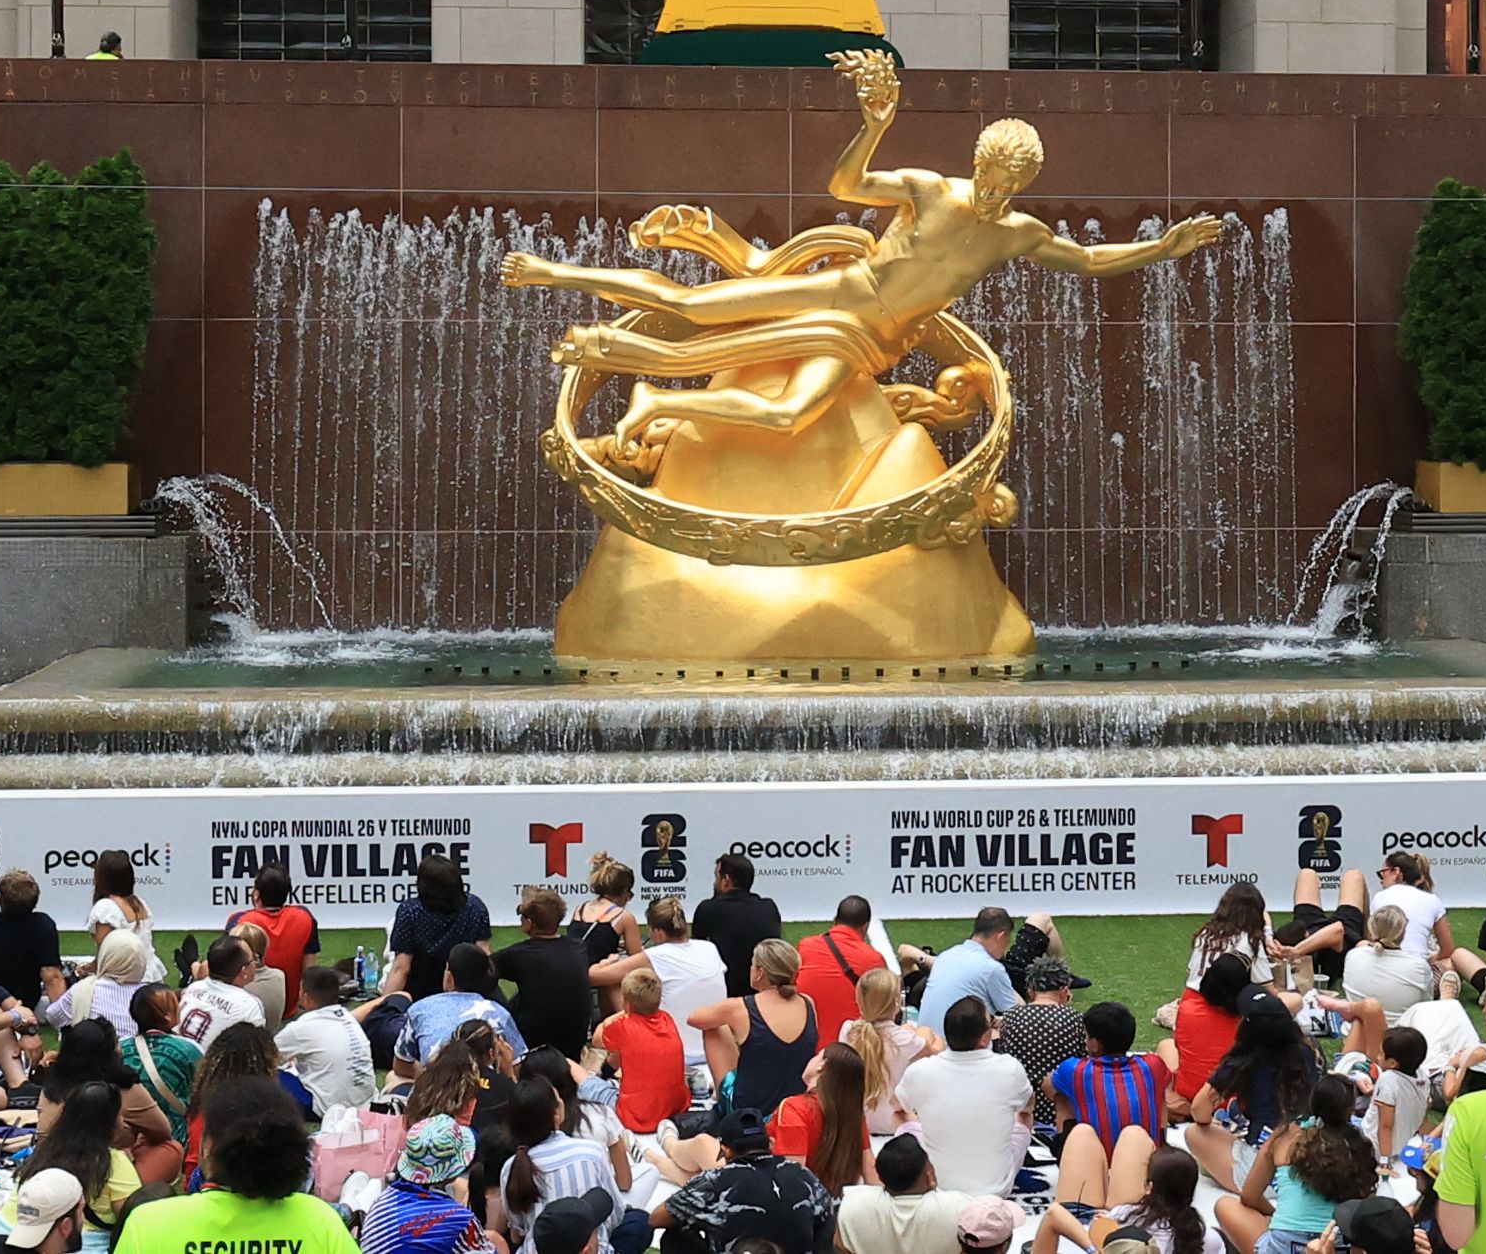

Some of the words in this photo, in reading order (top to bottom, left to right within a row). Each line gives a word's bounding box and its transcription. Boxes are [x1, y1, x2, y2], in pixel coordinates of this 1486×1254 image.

[212, 821, 249, 838] NYNJ
[252, 821, 288, 838] COPA
[292, 820, 354, 837] MUNDIAL
[357, 820, 375, 837] 26
[378, 820, 387, 836] Y
[391, 818, 471, 836] TELEMUNDO
[891, 810, 929, 829] NYNJ
[933, 810, 983, 829] WORLD
[987, 810, 1013, 828] CUP
[1017, 809, 1035, 828] 26
[1039, 810, 1050, 827] &
[1054, 808, 1136, 827] TELEMUNDO
[730, 834, 841, 858] peacock
[891, 834, 970, 868] FAN
[976, 832, 1136, 867] VILLAGE
[212, 844, 290, 879] FAN
[1310, 859, 1331, 868] FIFA
[1442, 858, 1453, 866] EN
[654, 869, 675, 878] FIFA
[790, 868, 803, 877] EN
[804, 867, 844, 877] ESPAÑOL
[1176, 873, 1258, 886] TELEMUNDO
[891, 875, 916, 894] AT
[922, 873, 1054, 894] ROCKEFELLER
[1060, 872, 1136, 892] CENTER
[212, 886, 238, 905] EN
[184, 1239, 303, 1254] SECURITY
